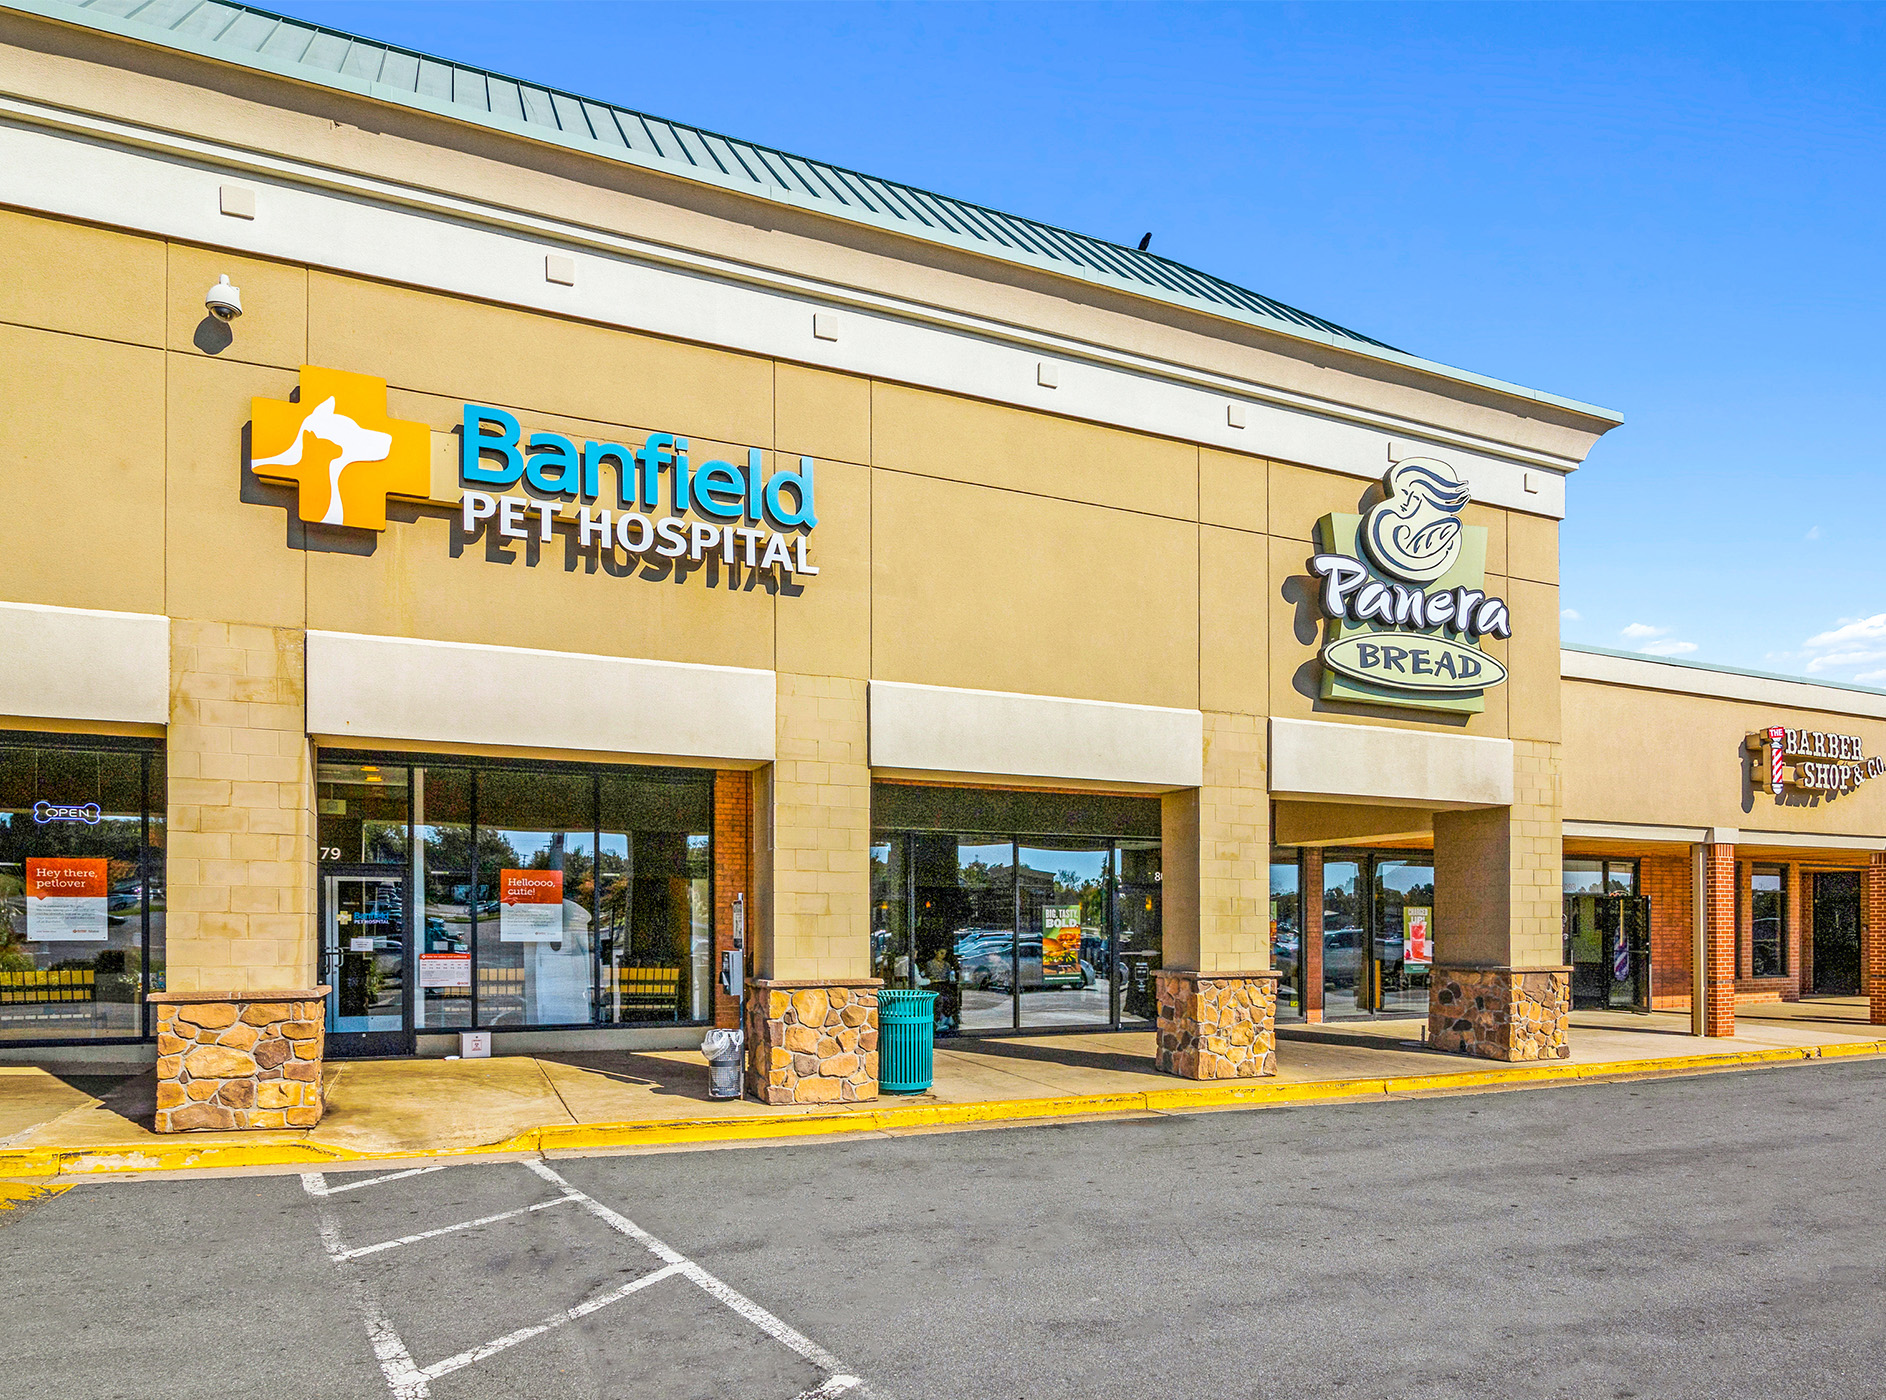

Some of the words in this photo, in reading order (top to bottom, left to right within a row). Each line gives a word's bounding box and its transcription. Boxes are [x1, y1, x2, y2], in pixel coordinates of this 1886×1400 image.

[463, 403, 819, 529] Banfield
[463, 490, 563, 543] PET
[580, 506, 820, 575] HOSPITAL
[1313, 554, 1512, 638] Panera
[1356, 643, 1482, 680] BREAD
[1769, 728, 1784, 737] THE
[1784, 728, 1864, 761] BARBER
[1804, 761, 1851, 790] SHOP
[1853, 764, 1867, 786] &
[45, 808, 90, 817] OPEN
[320, 847, 341, 860] 79
[36, 868, 61, 879] Hey
[63, 868, 98, 878] there,
[36, 879, 86, 889] petlover
[508, 878, 556, 888] Helloooo,
[1045, 909, 1059, 918] BIG.
[1045, 918, 1079, 929] BOLD.
